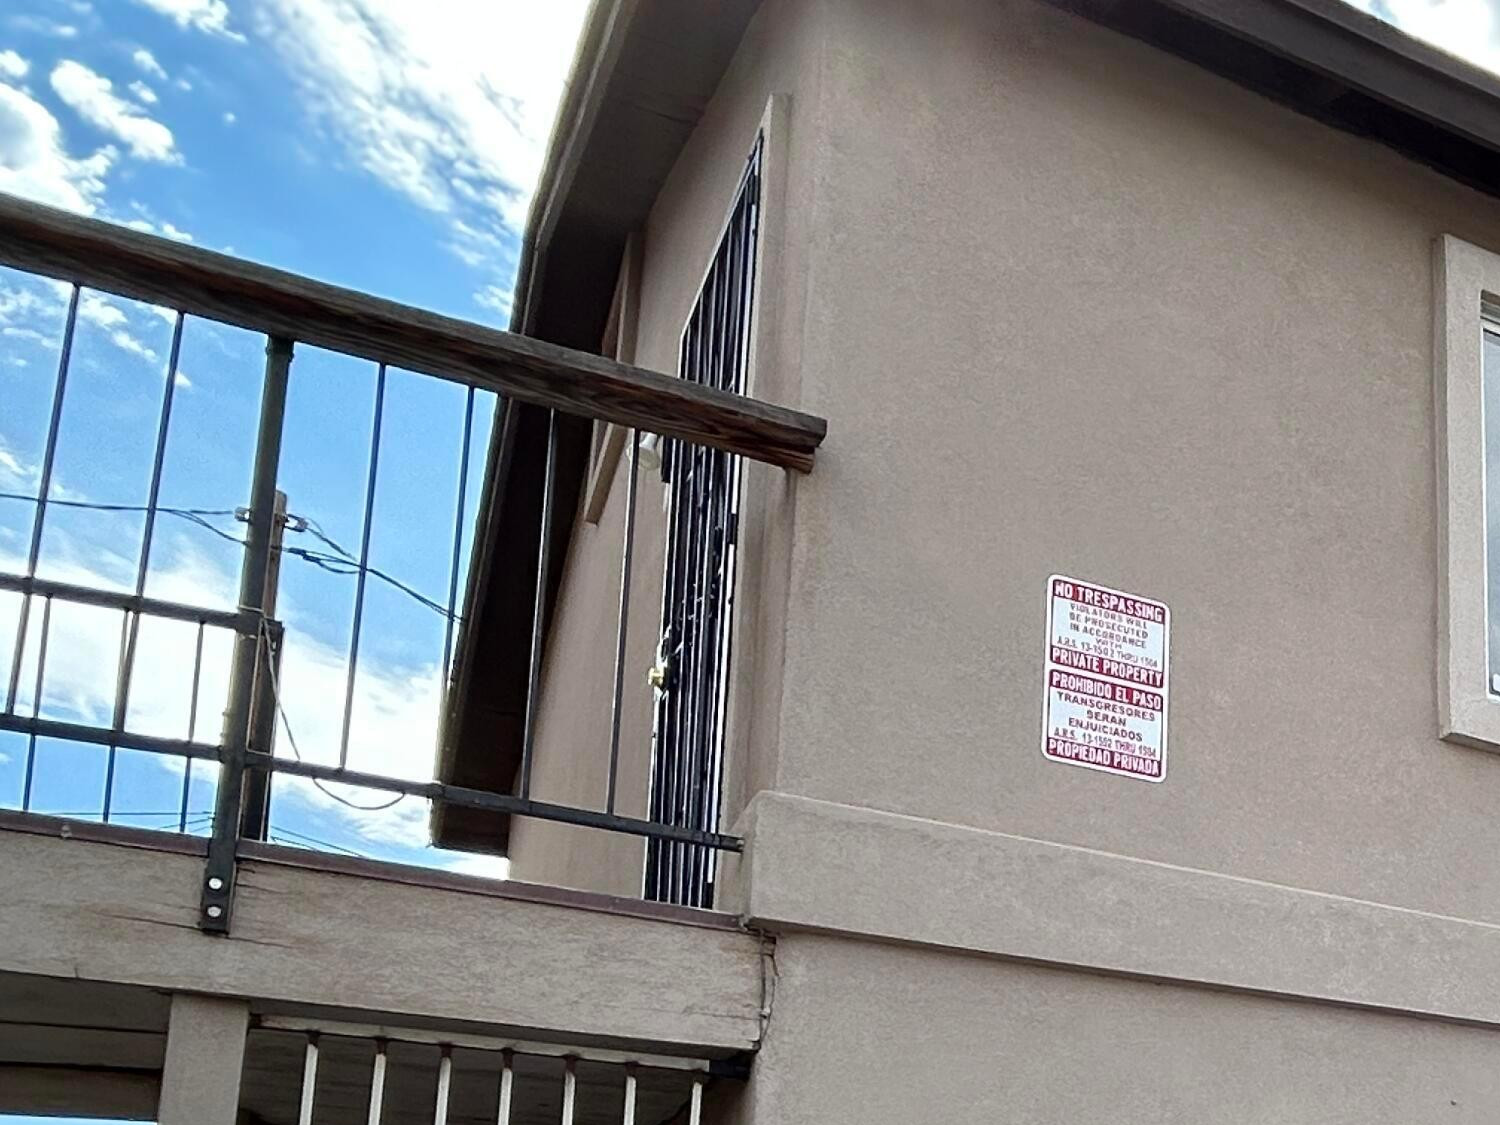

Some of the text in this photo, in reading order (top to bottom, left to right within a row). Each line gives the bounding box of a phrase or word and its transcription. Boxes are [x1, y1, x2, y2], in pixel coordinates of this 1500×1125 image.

[1055, 581, 1163, 622] NO TRESPASSING
[1070, 604, 1122, 622] VIOLATORS
[1070, 612, 1148, 639] BE PROSECUTED
[1070, 623, 1146, 649] IN ACCORDANCE
[1052, 647, 1162, 687] PRIVATE PROPERTY
[1052, 672, 1161, 709] PROHIBIDO EL PASO
[1057, 691, 1155, 721] TRANSGRESORES
[1087, 710, 1126, 726] SERAN
[1069, 717, 1142, 741] ENJUICIADOS
[1049, 739, 1159, 775] PROPIEDAD PRIVADA
